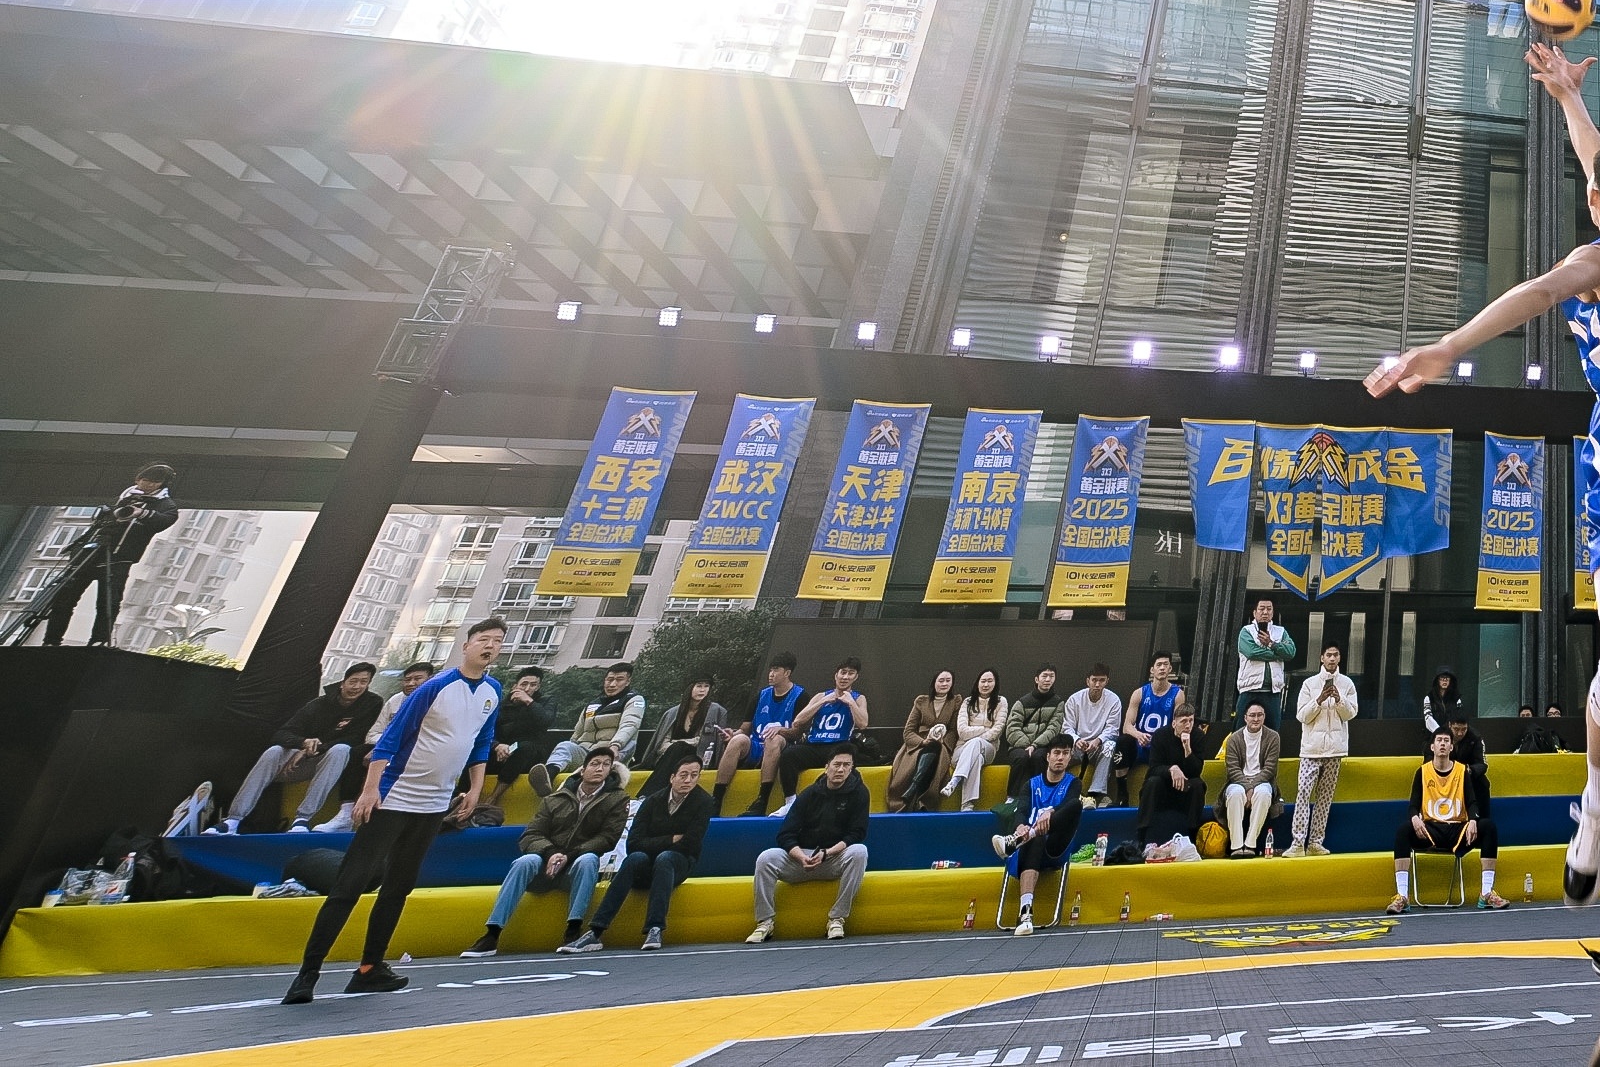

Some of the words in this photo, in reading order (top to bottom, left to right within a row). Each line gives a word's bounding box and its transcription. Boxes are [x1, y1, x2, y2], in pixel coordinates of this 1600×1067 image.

[612, 440, 658, 454] 黄金联赛
[735, 442, 778, 457] 黄金联赛
[858, 450, 899, 465] 黄金联赛
[974, 454, 1014, 468] 黄金联赛
[587, 455, 662, 493] 西安
[715, 459, 784, 495] 武汉
[838, 464, 905, 502] 天津
[957, 471, 1020, 504] 南京
[1080, 476, 1129, 495] 黄金联赛
[580, 494, 648, 521] 十三朝
[707, 499, 773, 520] ZWCC
[1070, 498, 1130, 520] 2025
[1266, 491, 1385, 526] X3黄金联赛
[1492, 490, 1532, 508] 黄金联赛
[831, 501, 895, 529] 天津斗牛
[1486, 508, 1534, 532] 2025
[566, 523, 637, 543] 全国总决赛
[699, 526, 763, 546] 全国总决赛
[825, 529, 888, 551] 全国总决赛
[946, 534, 1006, 553] 全国总决赛
[1062, 525, 1132, 548] 全国总决赛
[1482, 534, 1539, 557] 全国总决赛
[1427, 797, 1462, 821] 101
